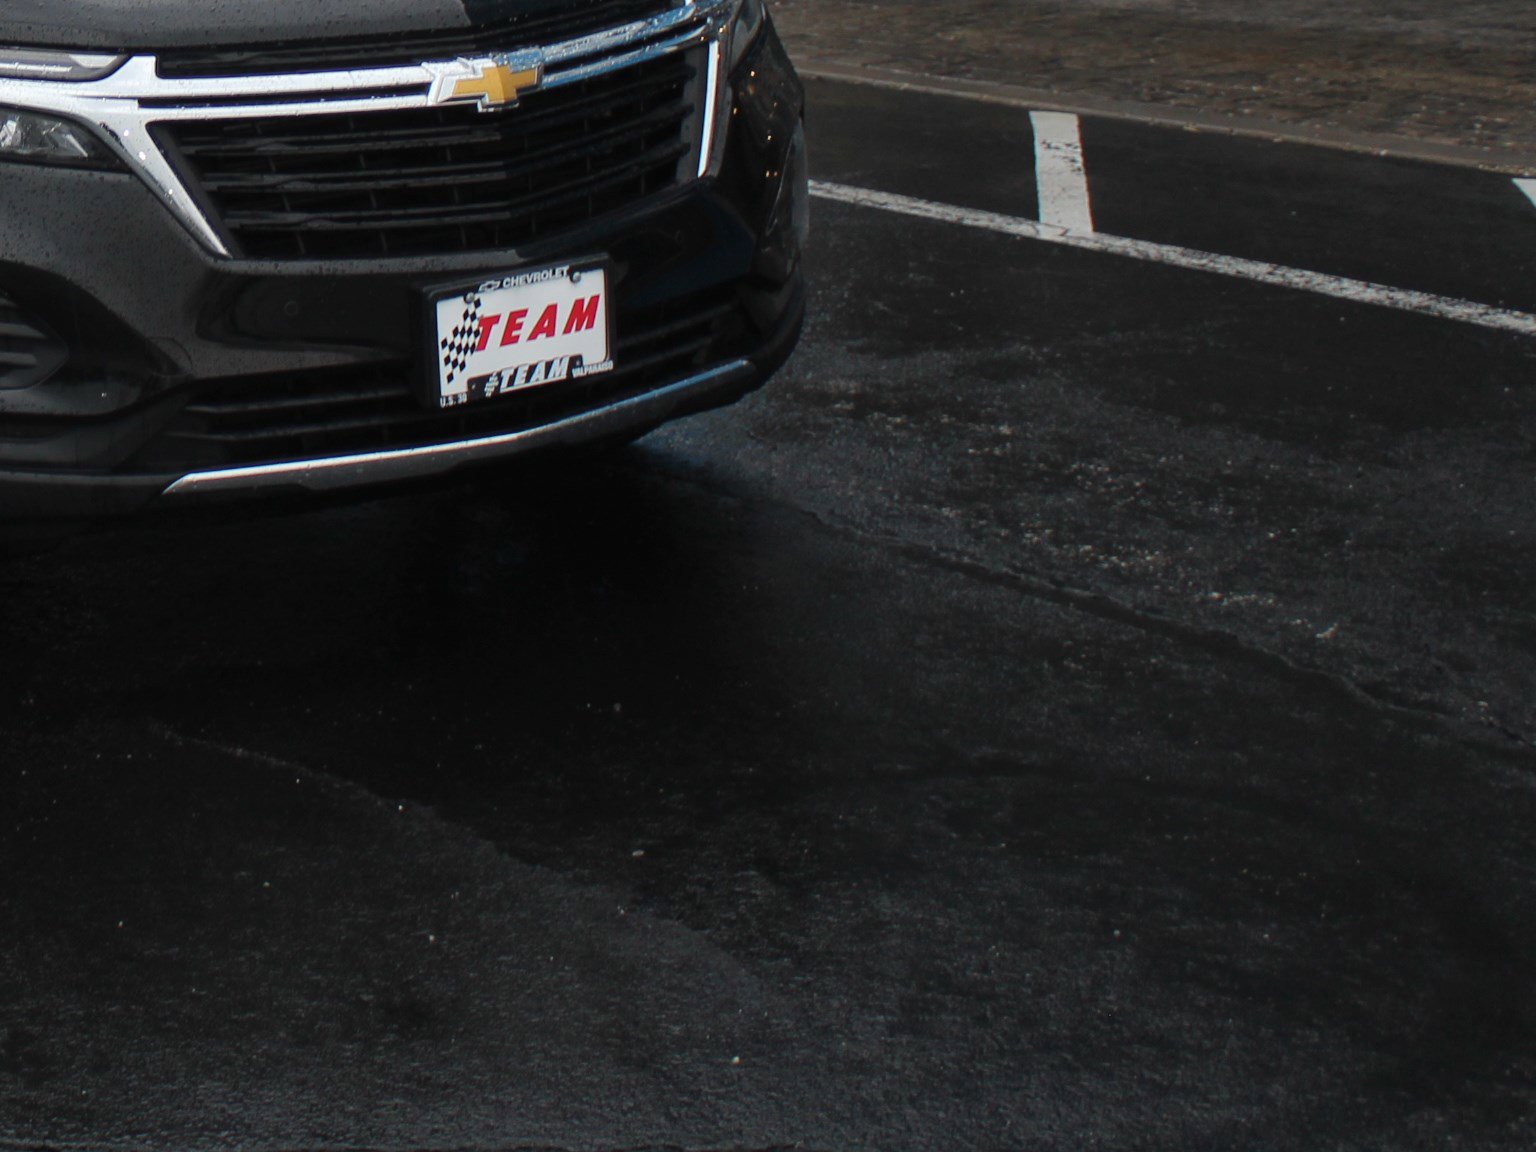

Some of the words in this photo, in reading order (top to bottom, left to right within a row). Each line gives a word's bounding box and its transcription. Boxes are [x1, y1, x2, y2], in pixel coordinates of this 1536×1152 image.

[502, 265, 571, 289] CHEVROLET
[475, 294, 600, 352] TEAM
[499, 355, 571, 393] TEAM
